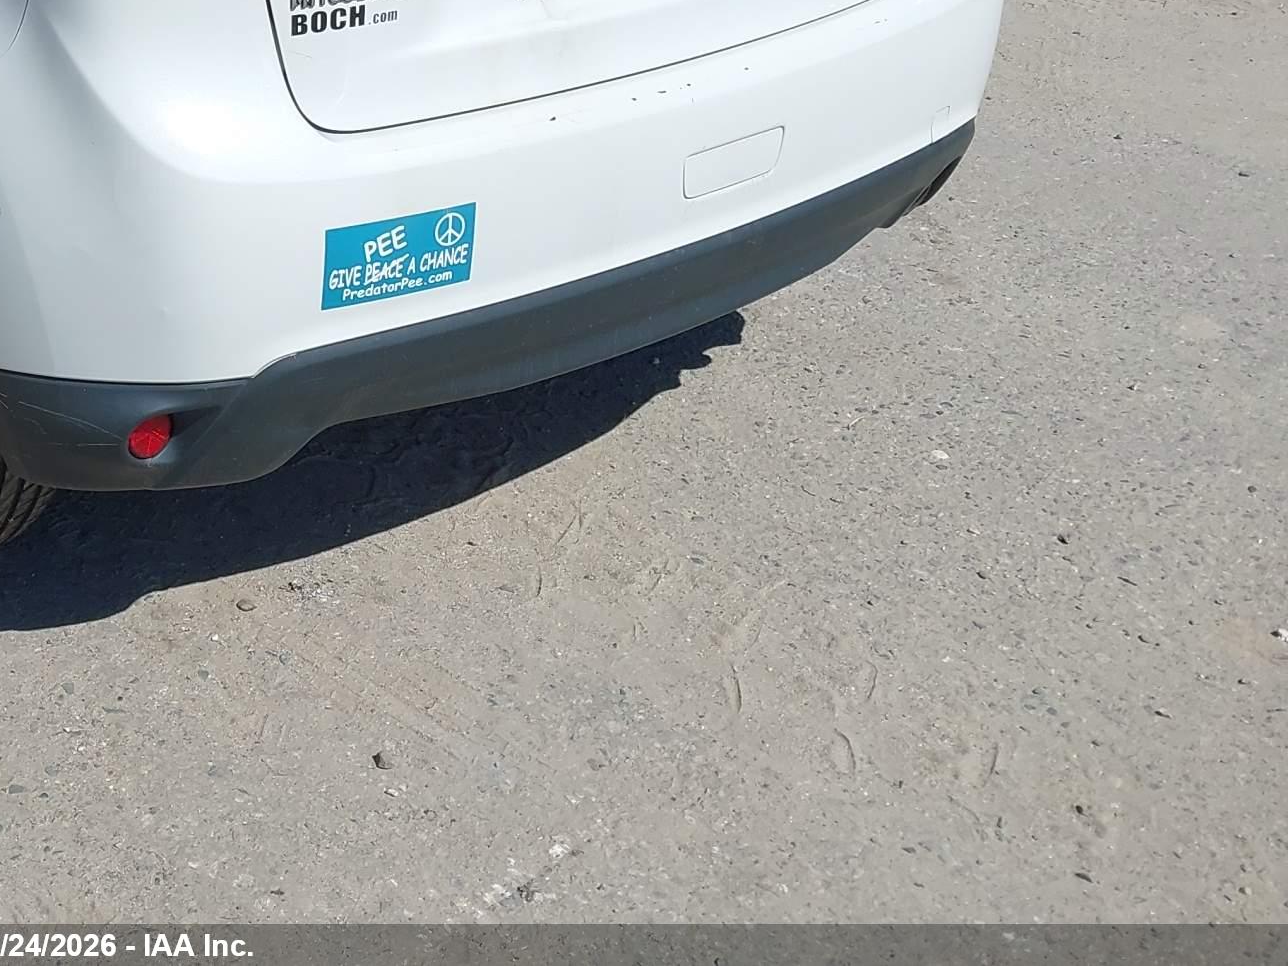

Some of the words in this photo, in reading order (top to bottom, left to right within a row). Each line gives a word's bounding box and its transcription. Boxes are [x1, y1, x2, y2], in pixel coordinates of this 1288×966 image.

[363, 225, 408, 263] PEE
[329, 265, 363, 290] GIVE
[364, 255, 404, 285] PEACE
[406, 256, 417, 276] A
[419, 243, 470, 273] CHANCE
[342, 270, 453, 302] PredatorPee.com
